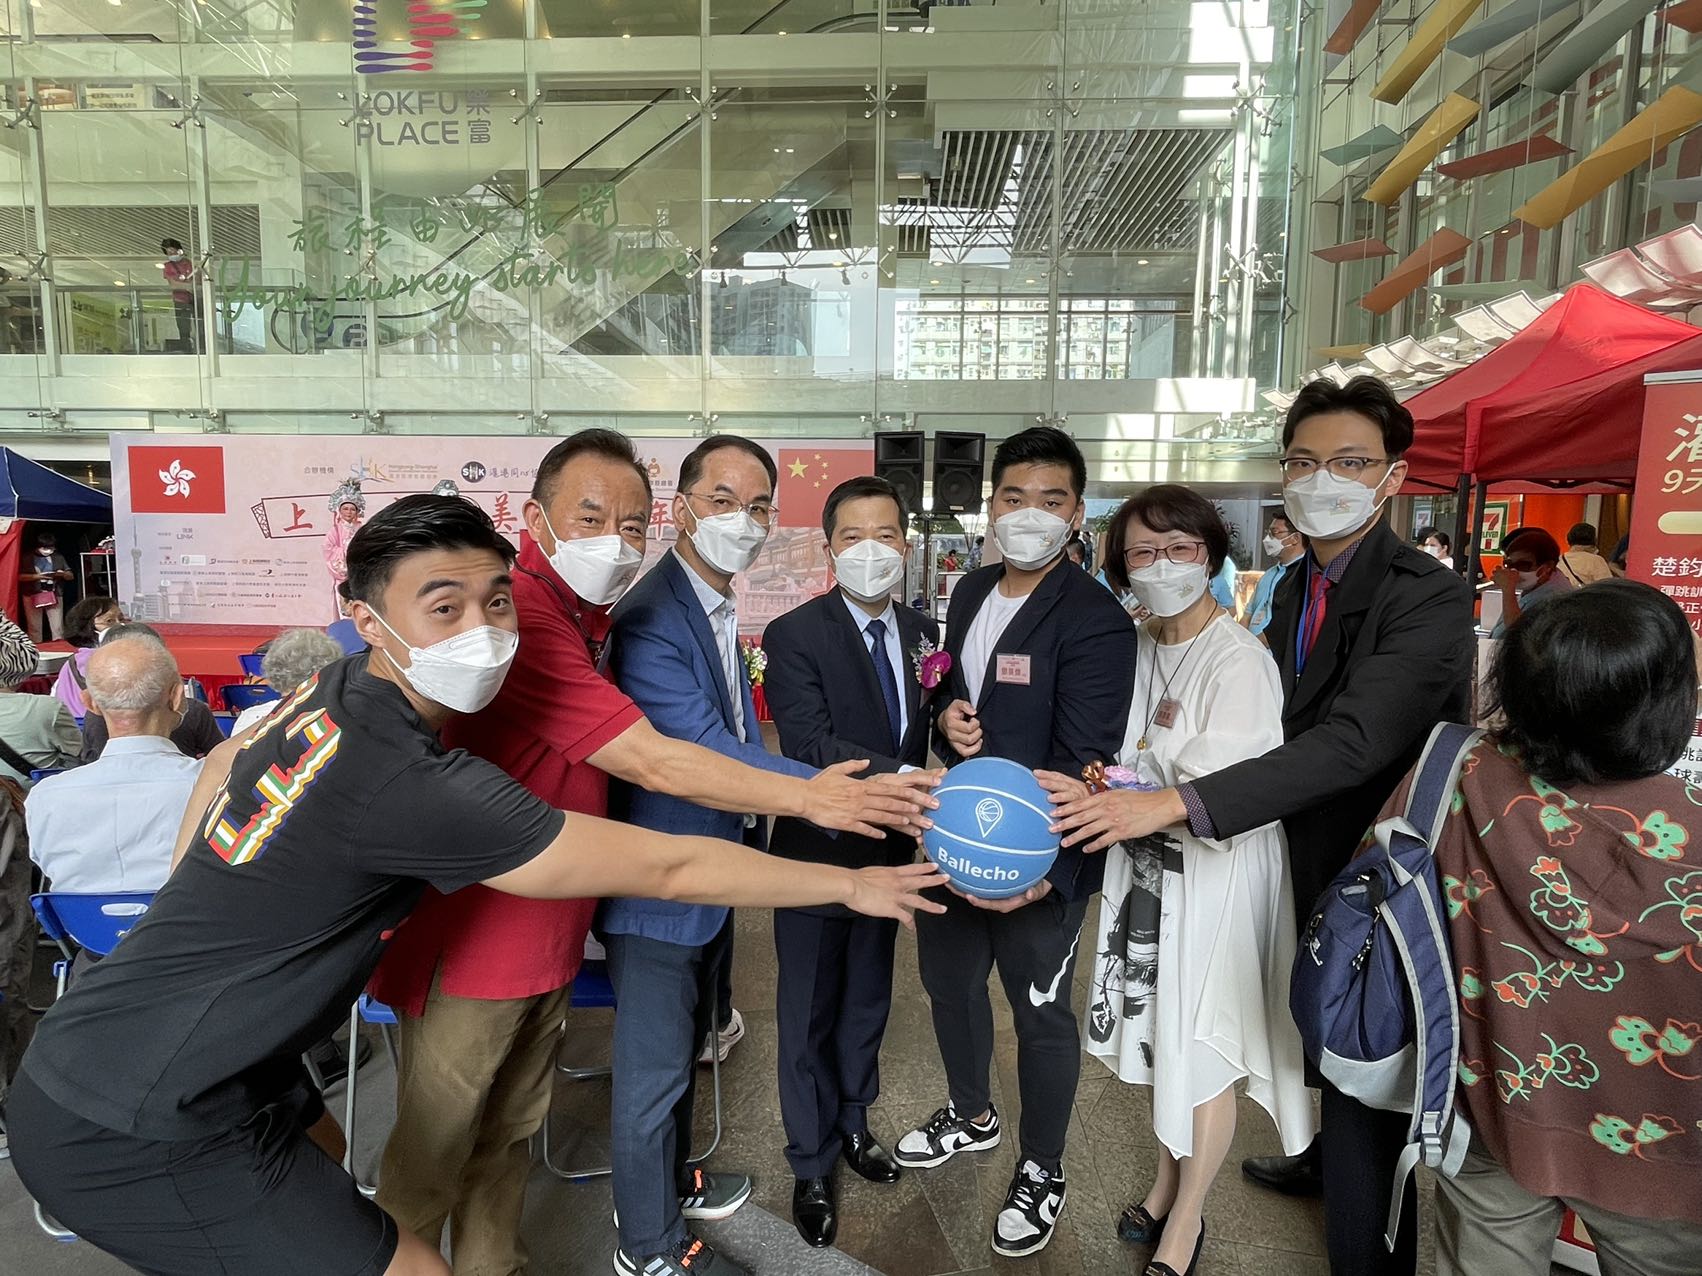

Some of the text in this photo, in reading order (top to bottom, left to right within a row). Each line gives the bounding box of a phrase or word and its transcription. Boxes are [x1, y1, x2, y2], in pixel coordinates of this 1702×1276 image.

[355, 90, 459, 116] LOKFU
[356, 121, 459, 146] PLACE
[219, 255, 312, 323] Your
[313, 261, 480, 334] journey
[491, 243, 598, 294] starts
[282, 503, 312, 532] 上
[492, 493, 518, 531] 美
[937, 846, 1020, 882] Ballecho
